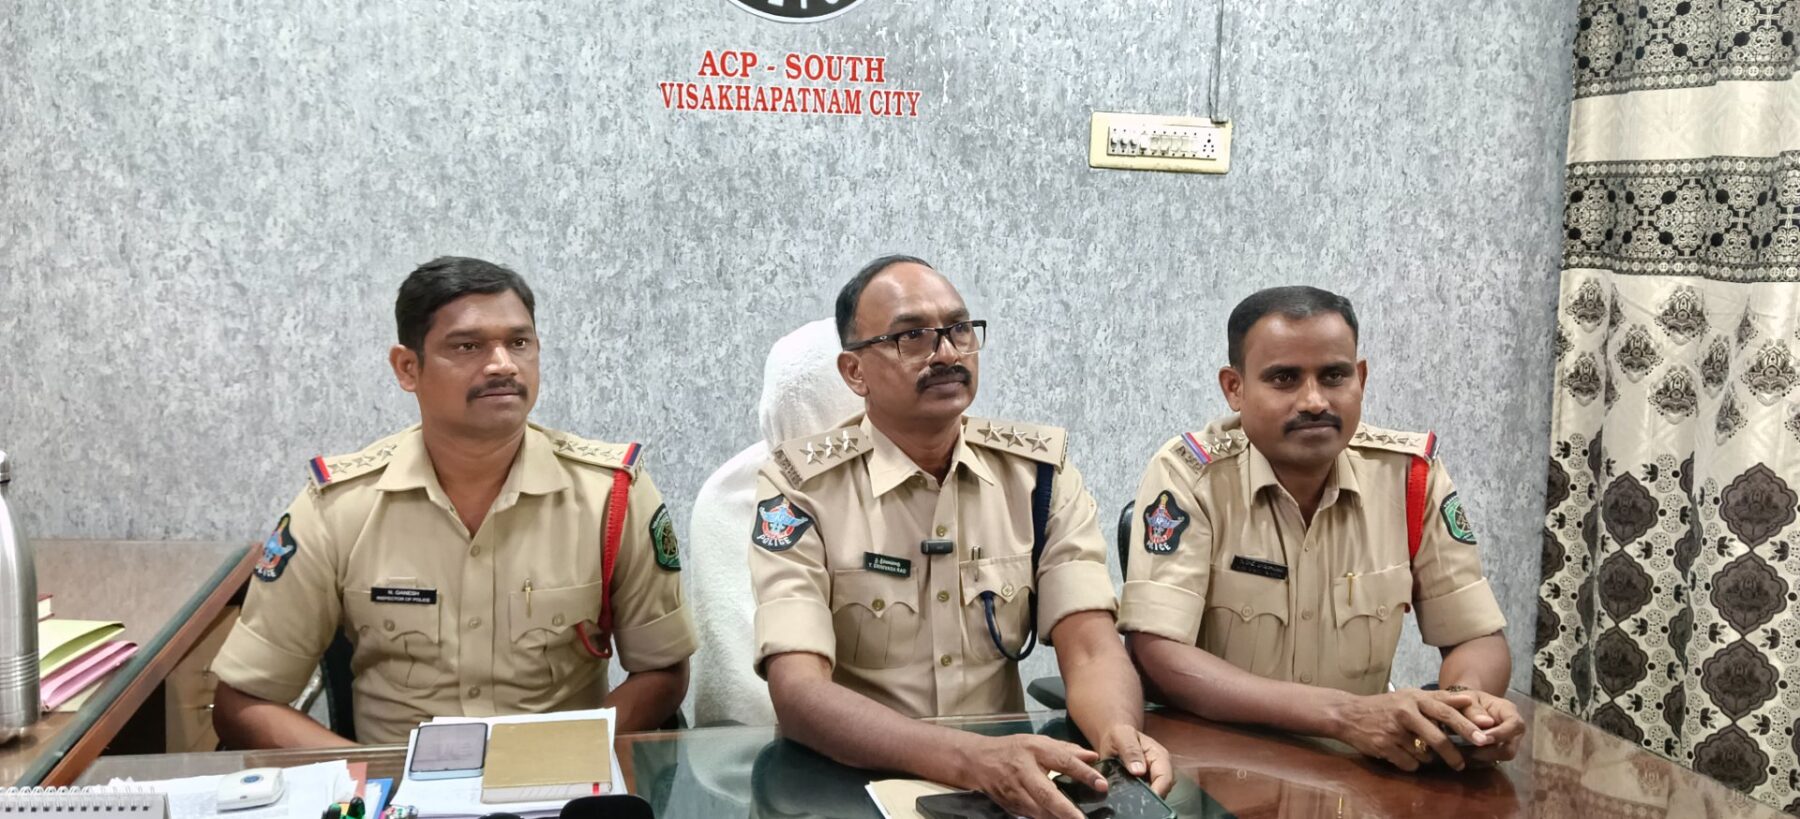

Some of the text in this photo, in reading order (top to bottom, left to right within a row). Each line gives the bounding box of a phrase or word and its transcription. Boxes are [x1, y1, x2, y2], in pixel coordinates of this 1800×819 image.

[697, 49, 758, 78] ACP
[785, 52, 886, 84] SOUTH
[659, 82, 922, 117] VISAKHAPATNAM CITY
[756, 534, 792, 547] POLICE
